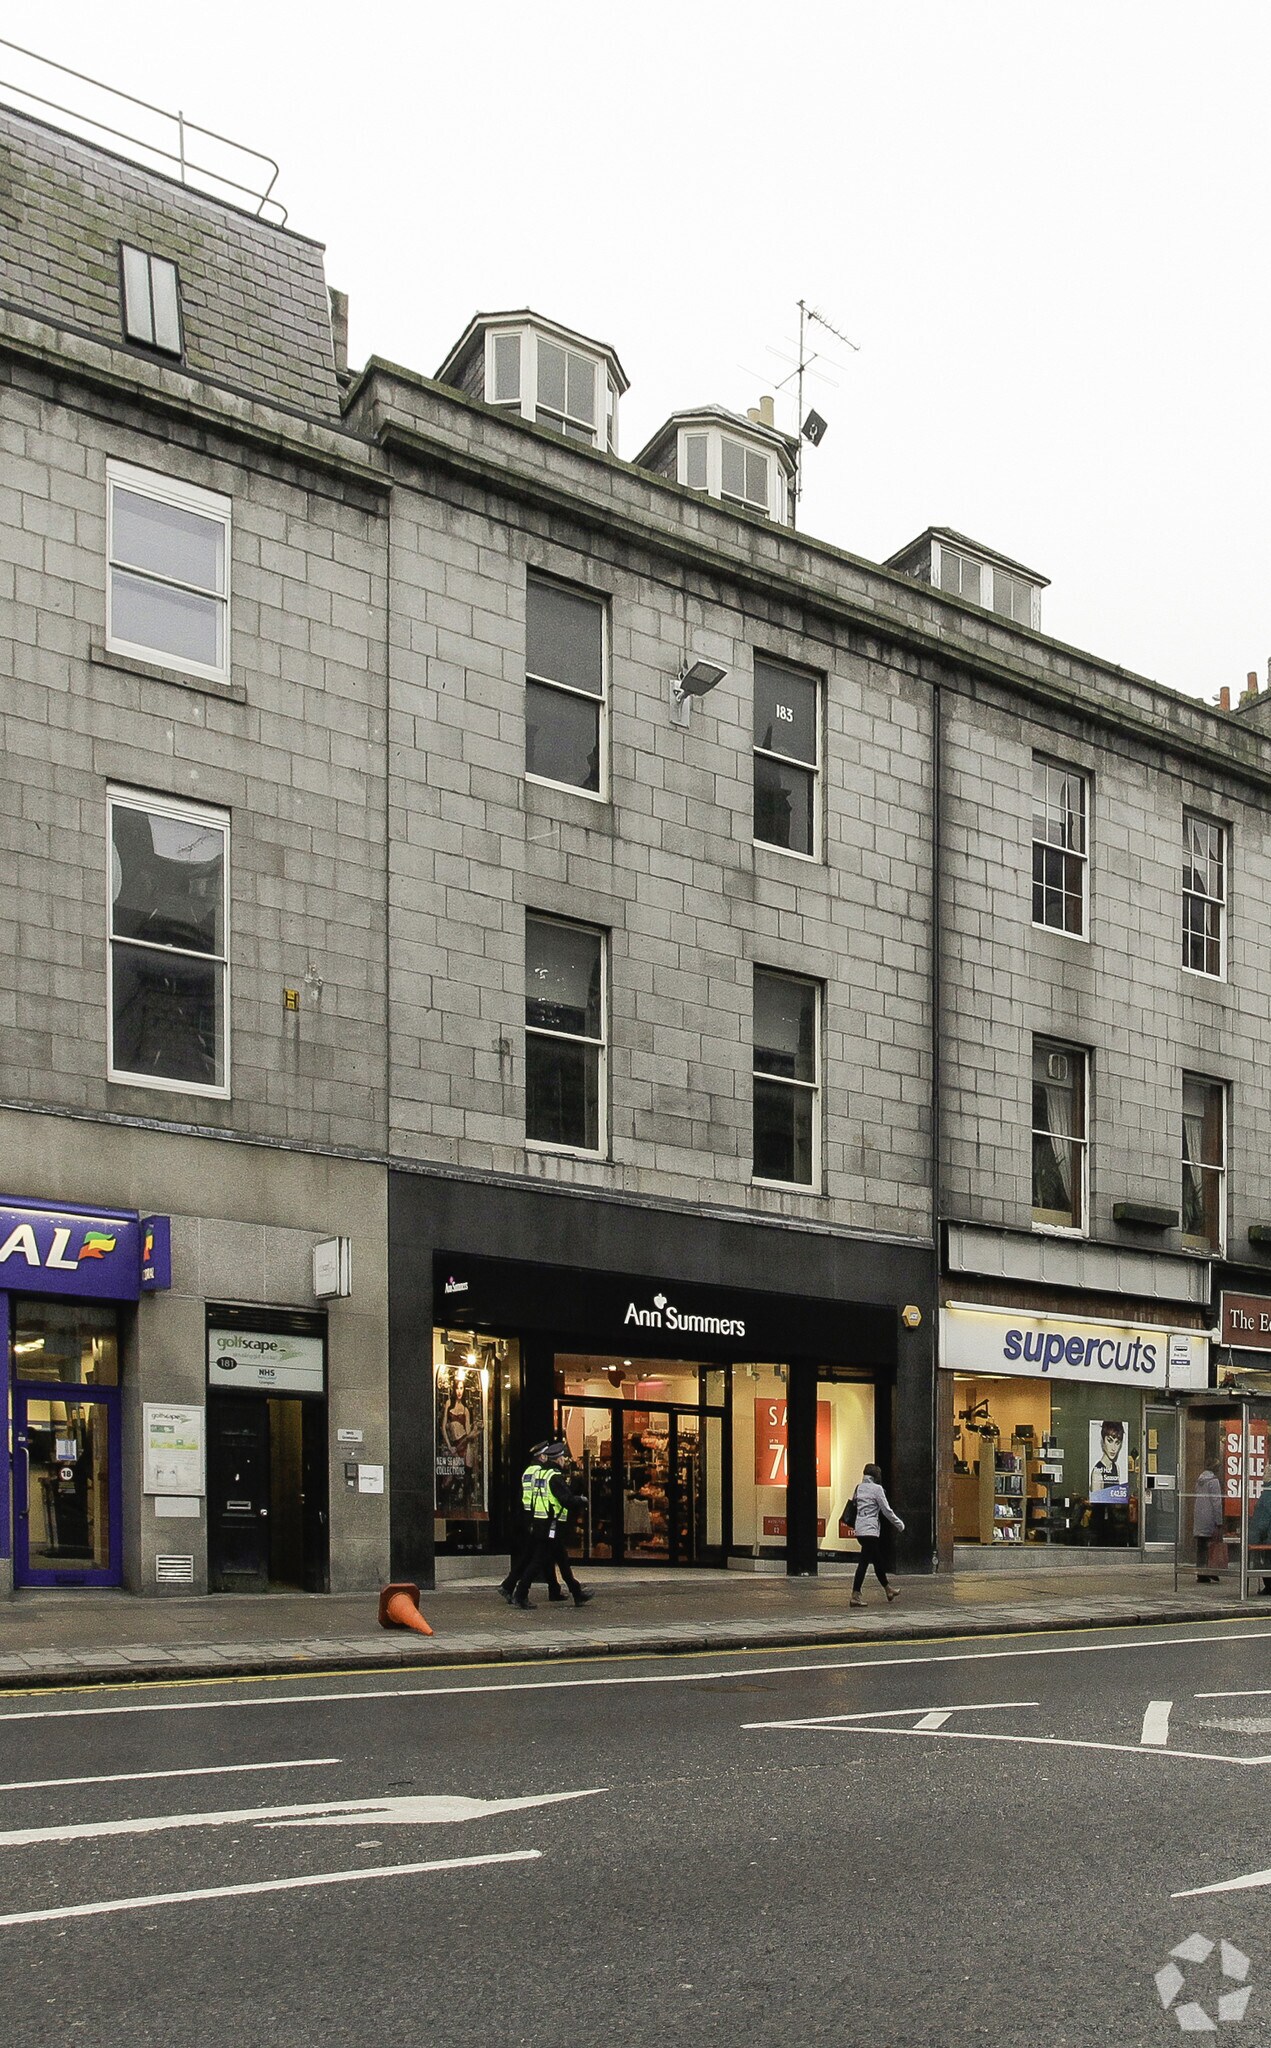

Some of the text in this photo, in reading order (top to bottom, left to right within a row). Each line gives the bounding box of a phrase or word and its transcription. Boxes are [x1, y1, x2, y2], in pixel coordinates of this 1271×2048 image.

[776, 704, 793, 722] 183
[624, 1302, 746, 1337] Ann Summers
[1230, 1308, 1255, 1330] The
[217, 1335, 278, 1354] golfscape
[1003, 1329, 1157, 1374] supercuts
[220, 1359, 234, 1368] 181
[258, 1368, 275, 1377] NHS
[62, 1470, 72, 1478] 18
